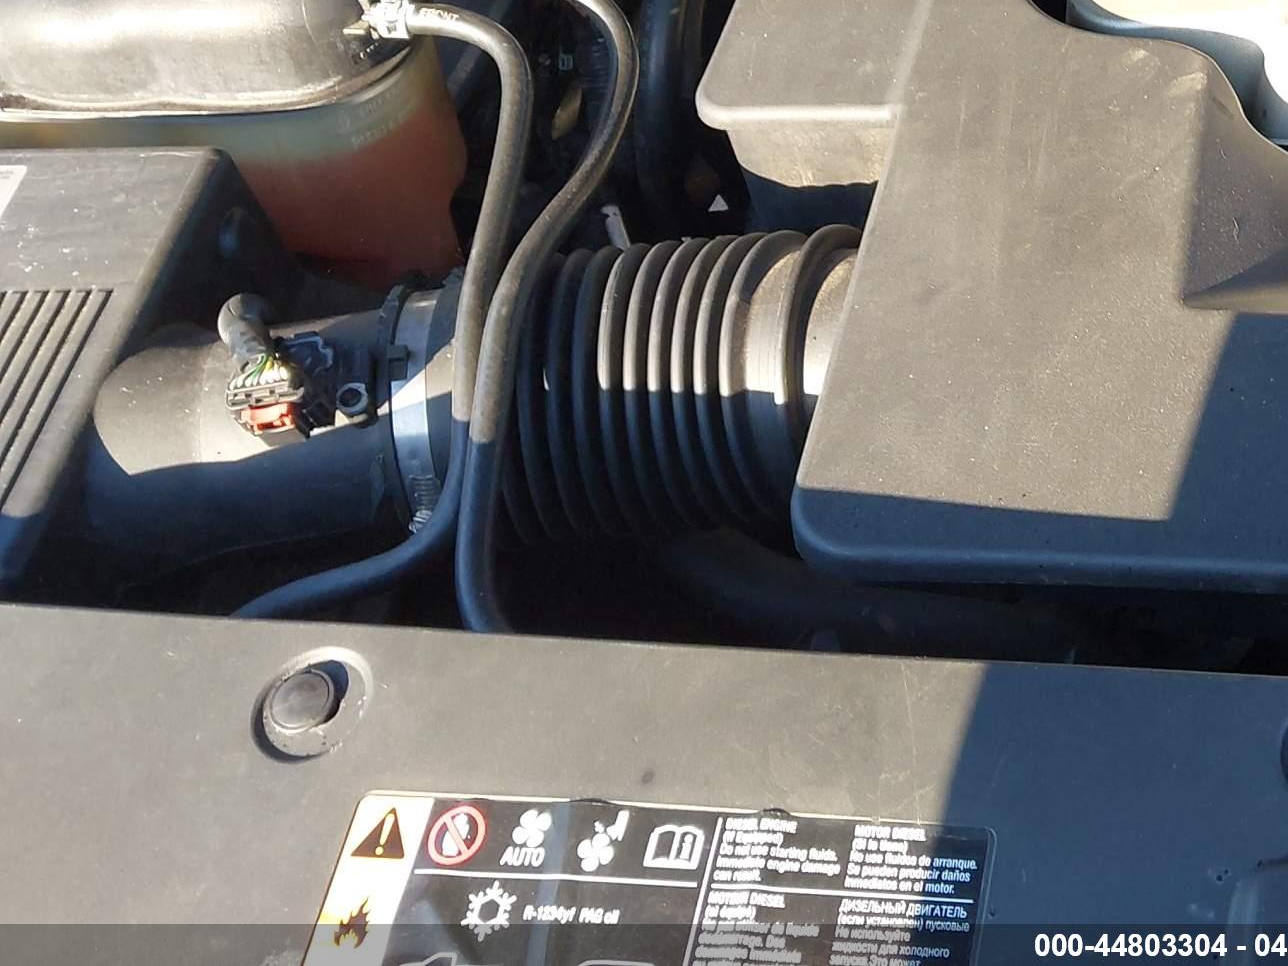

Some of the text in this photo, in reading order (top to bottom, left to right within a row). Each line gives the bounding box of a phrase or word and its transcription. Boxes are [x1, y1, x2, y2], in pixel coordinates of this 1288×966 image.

[419, 7, 460, 22] FRONT
[500, 846, 546, 867] AUTO
[720, 843, 734, 854] Do
[751, 845, 769, 856] use
[770, 847, 807, 861] starting
[767, 860, 800, 873] engine
[801, 861, 840, 876] damage
[865, 853, 884, 864] use
[918, 855, 931, 866] de
[933, 857, 978, 870] arranque.
[714, 871, 732, 881] can
[861, 865, 898, 878] pueden
[899, 867, 939, 880] producir
[941, 869, 971, 882] daños
[899, 881, 912, 891] en
[925, 882, 954, 894] motor.
[523, 905, 620, 924] R-1234yf PAG oil
[906, 903, 967, 919] ДВИГАТЕЛЬ
[835, 926, 911, 943] Не используйте
[926, 921, 970, 933] пусковые
[899, 945, 950, 958] холодного
